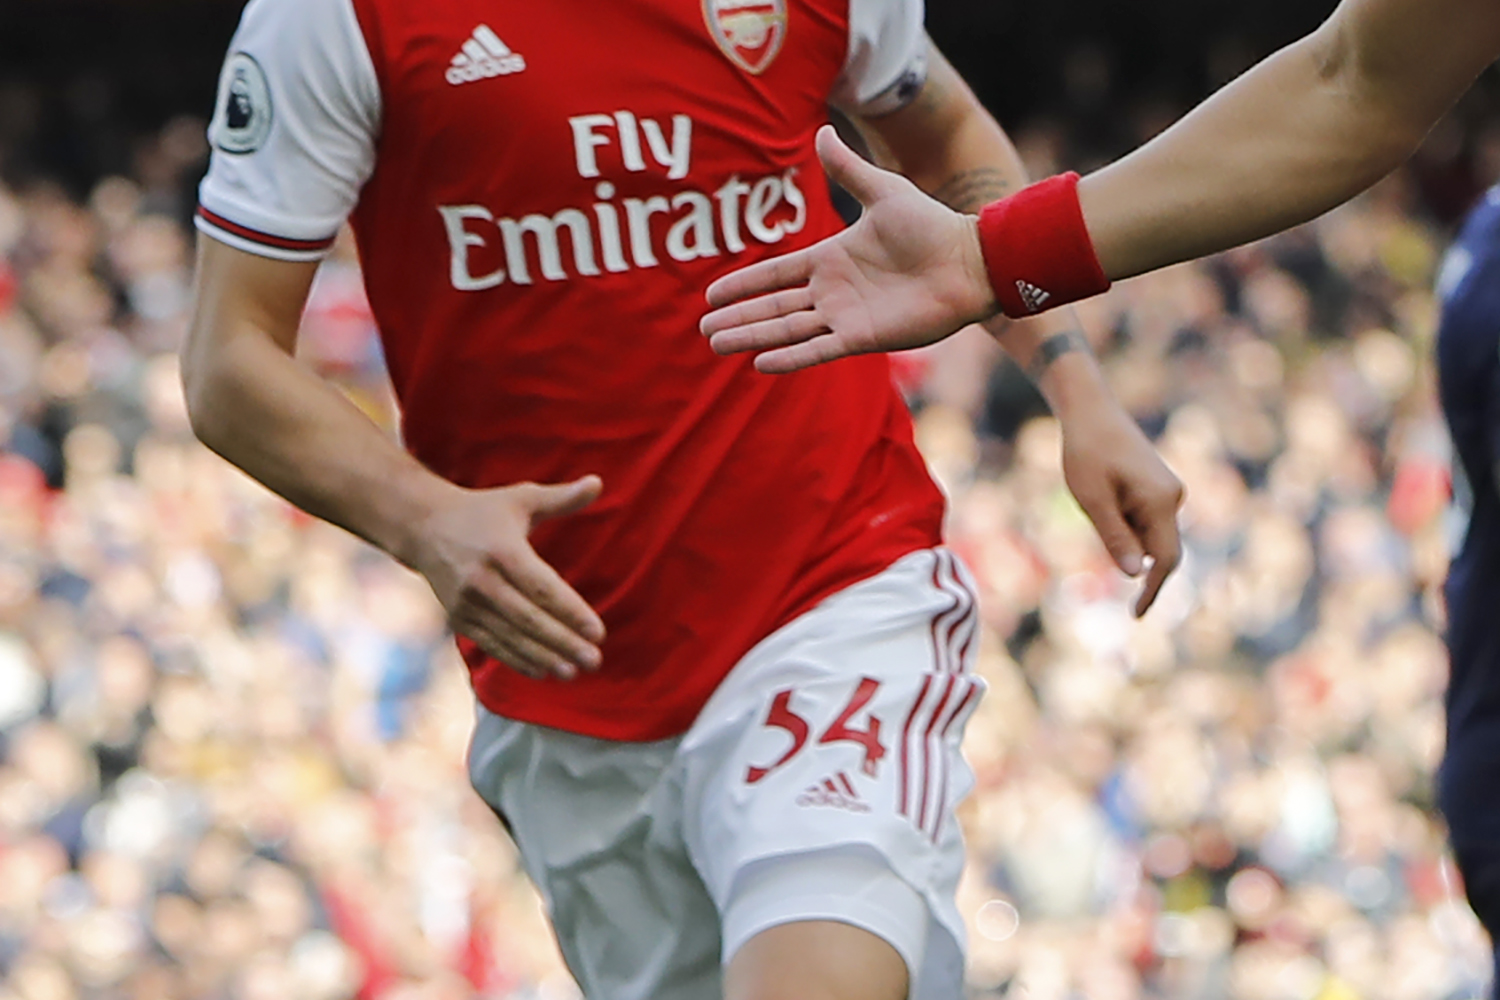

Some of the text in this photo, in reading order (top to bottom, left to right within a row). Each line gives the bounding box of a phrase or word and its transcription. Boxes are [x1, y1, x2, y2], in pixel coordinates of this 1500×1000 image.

[444, 52, 527, 86] adidas
[568, 110, 692, 179] Fly
[437, 168, 806, 290] Emirates
[743, 676, 888, 784] 54
